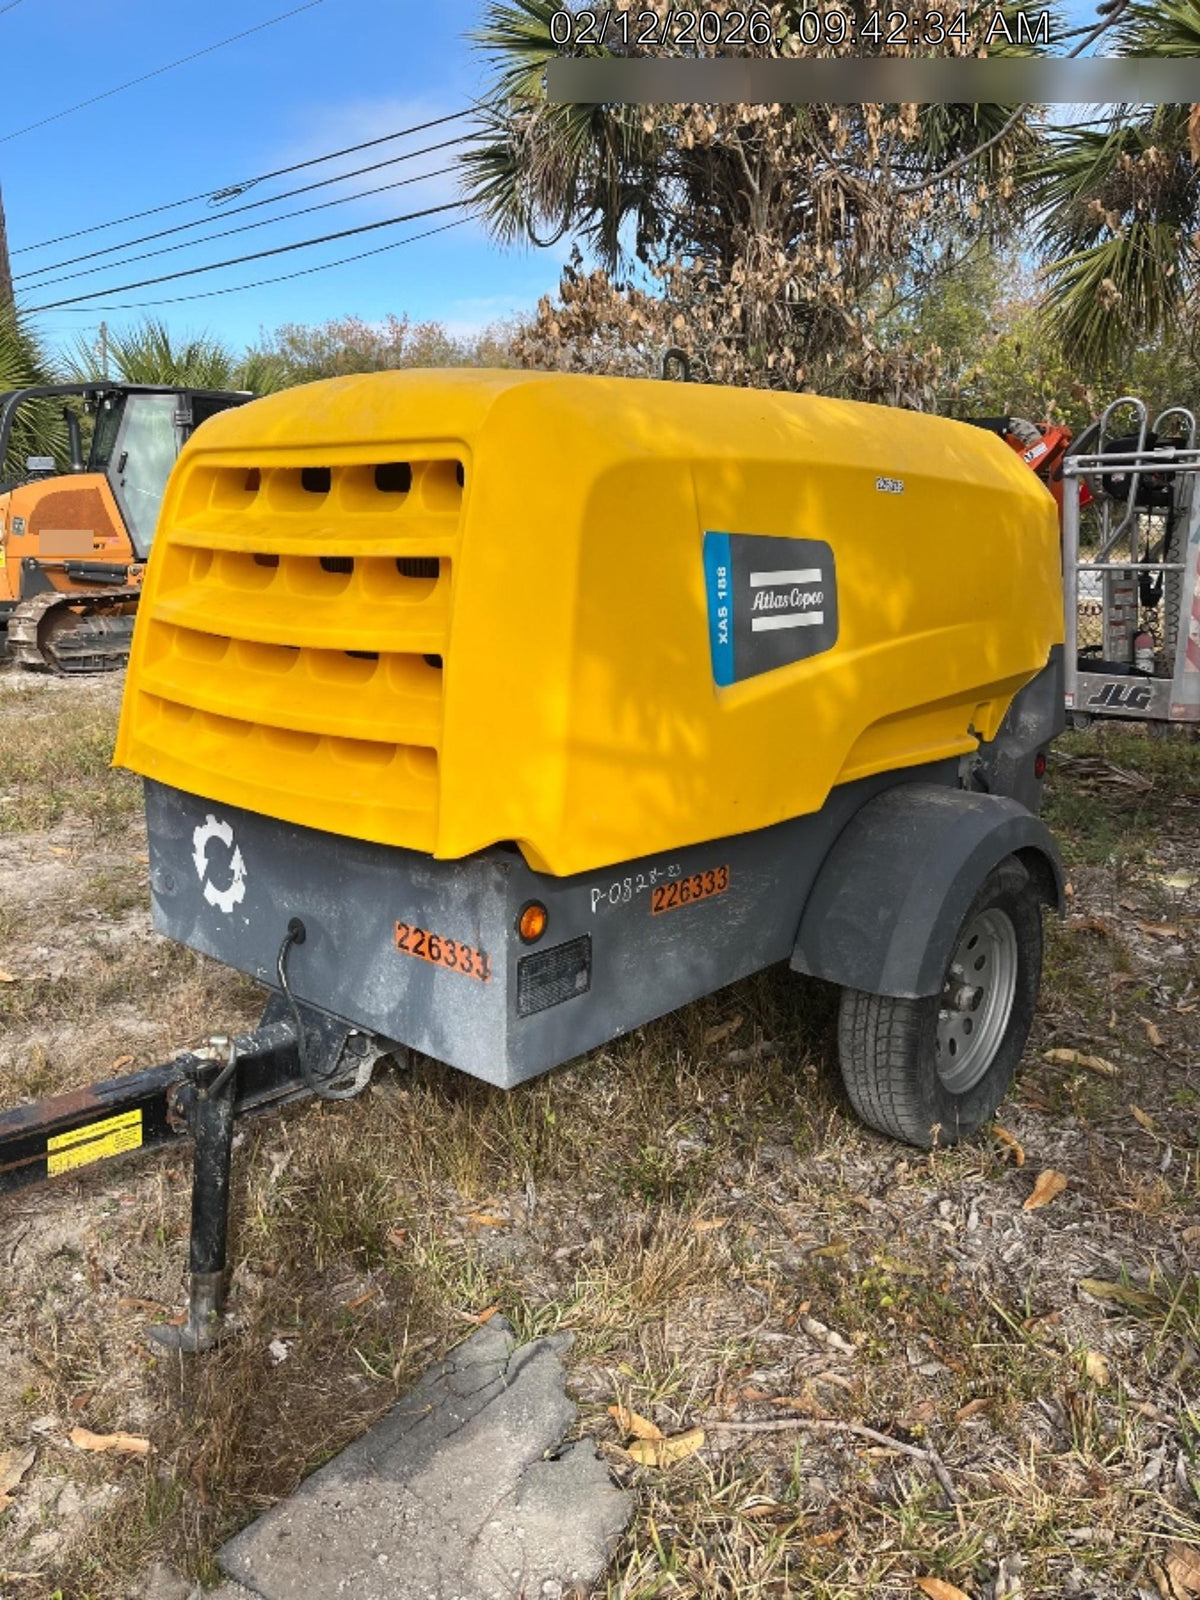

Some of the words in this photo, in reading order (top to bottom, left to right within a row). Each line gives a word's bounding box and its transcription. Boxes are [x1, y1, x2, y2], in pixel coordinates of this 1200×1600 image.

[717, 566, 728, 600] 188
[750, 590, 788, 611] Atlas
[790, 588, 824, 610] Copco
[717, 606, 728, 644] XAS
[1087, 683, 1152, 711] JLG
[654, 867, 728, 912] 226333
[397, 922, 491, 981] 226333
